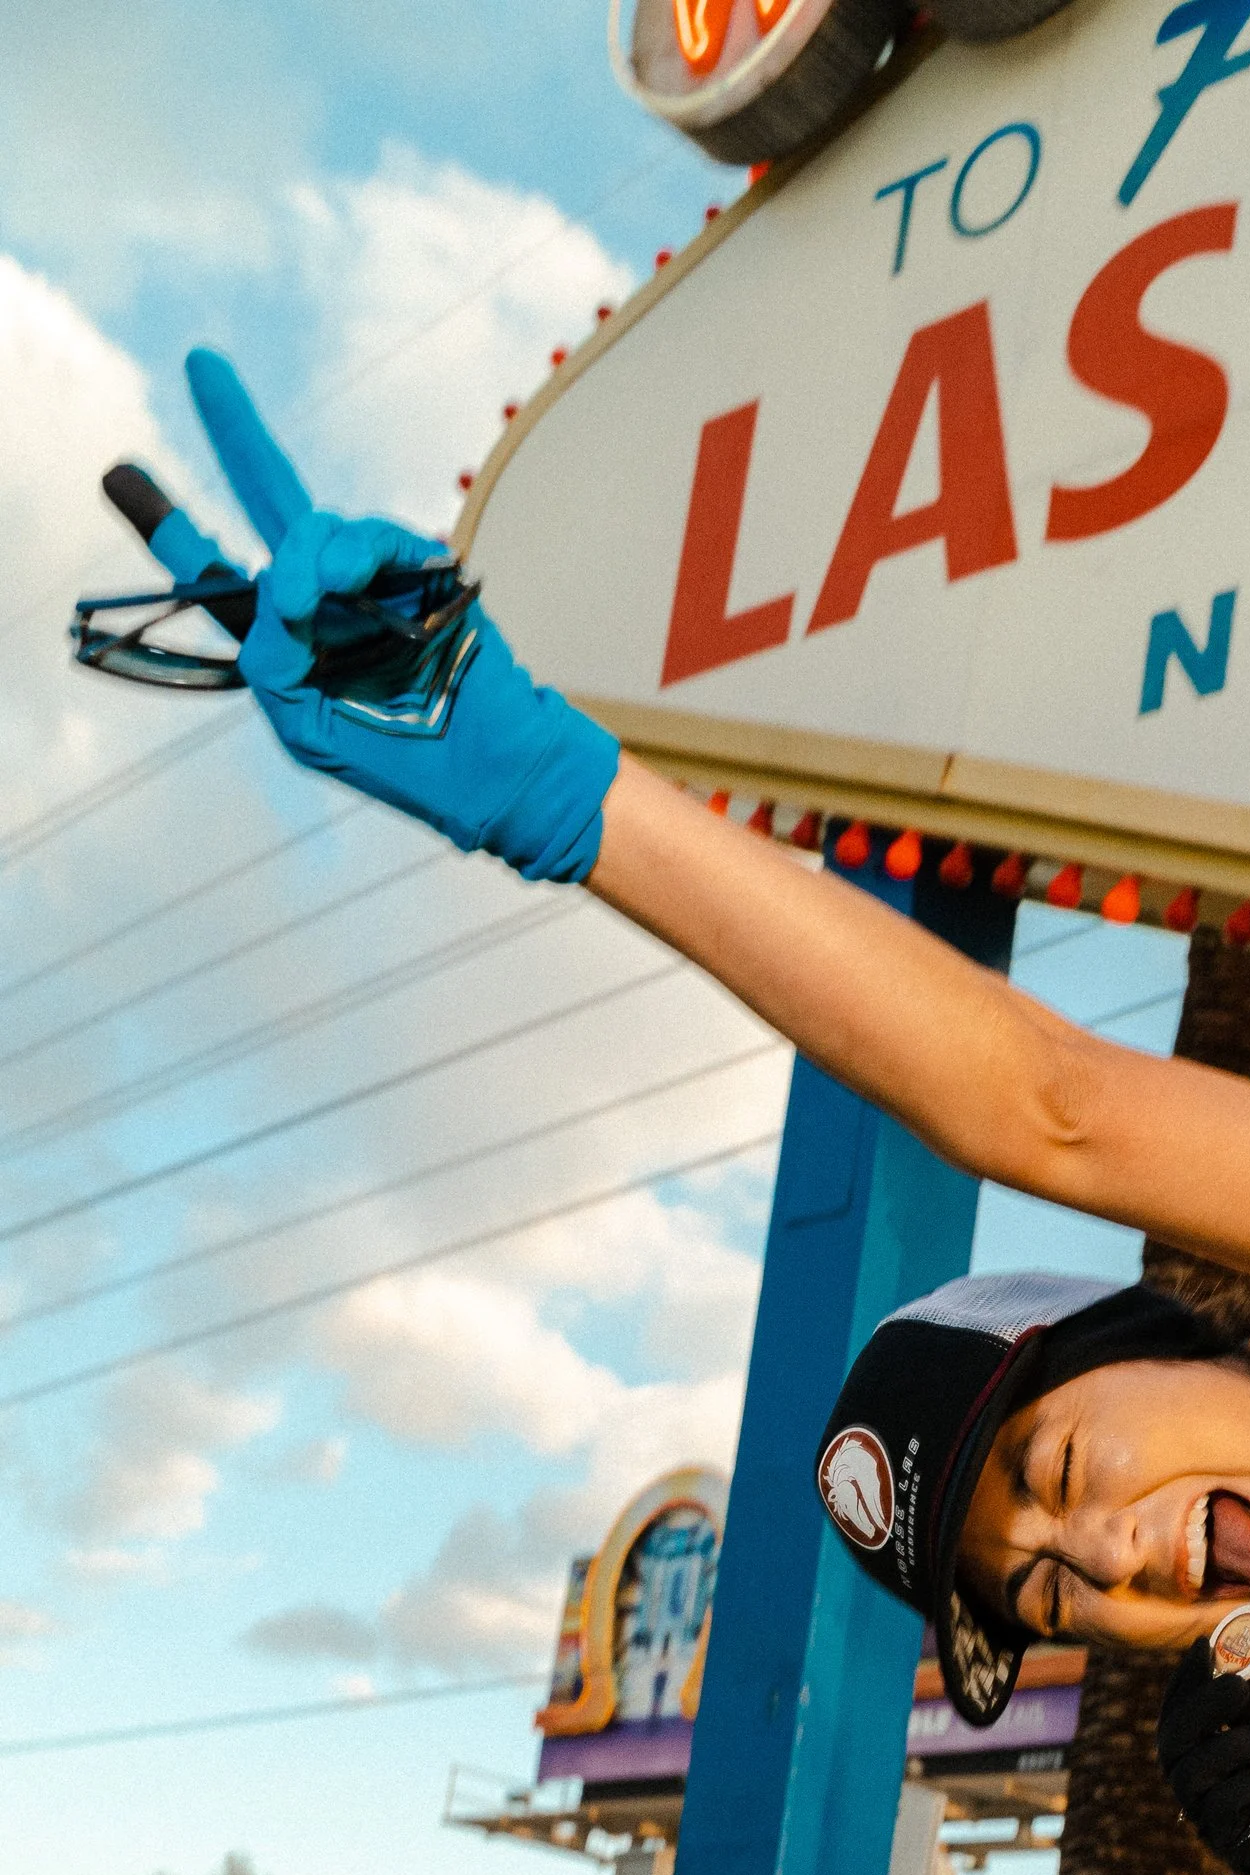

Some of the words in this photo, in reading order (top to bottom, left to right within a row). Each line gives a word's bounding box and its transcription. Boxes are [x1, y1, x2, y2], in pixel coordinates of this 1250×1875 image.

[875, 122, 1042, 275] TO
[660, 201, 1240, 690] LAS
[899, 1438, 920, 1491] LAB
[907, 1472, 921, 1566] ENDURANCE
